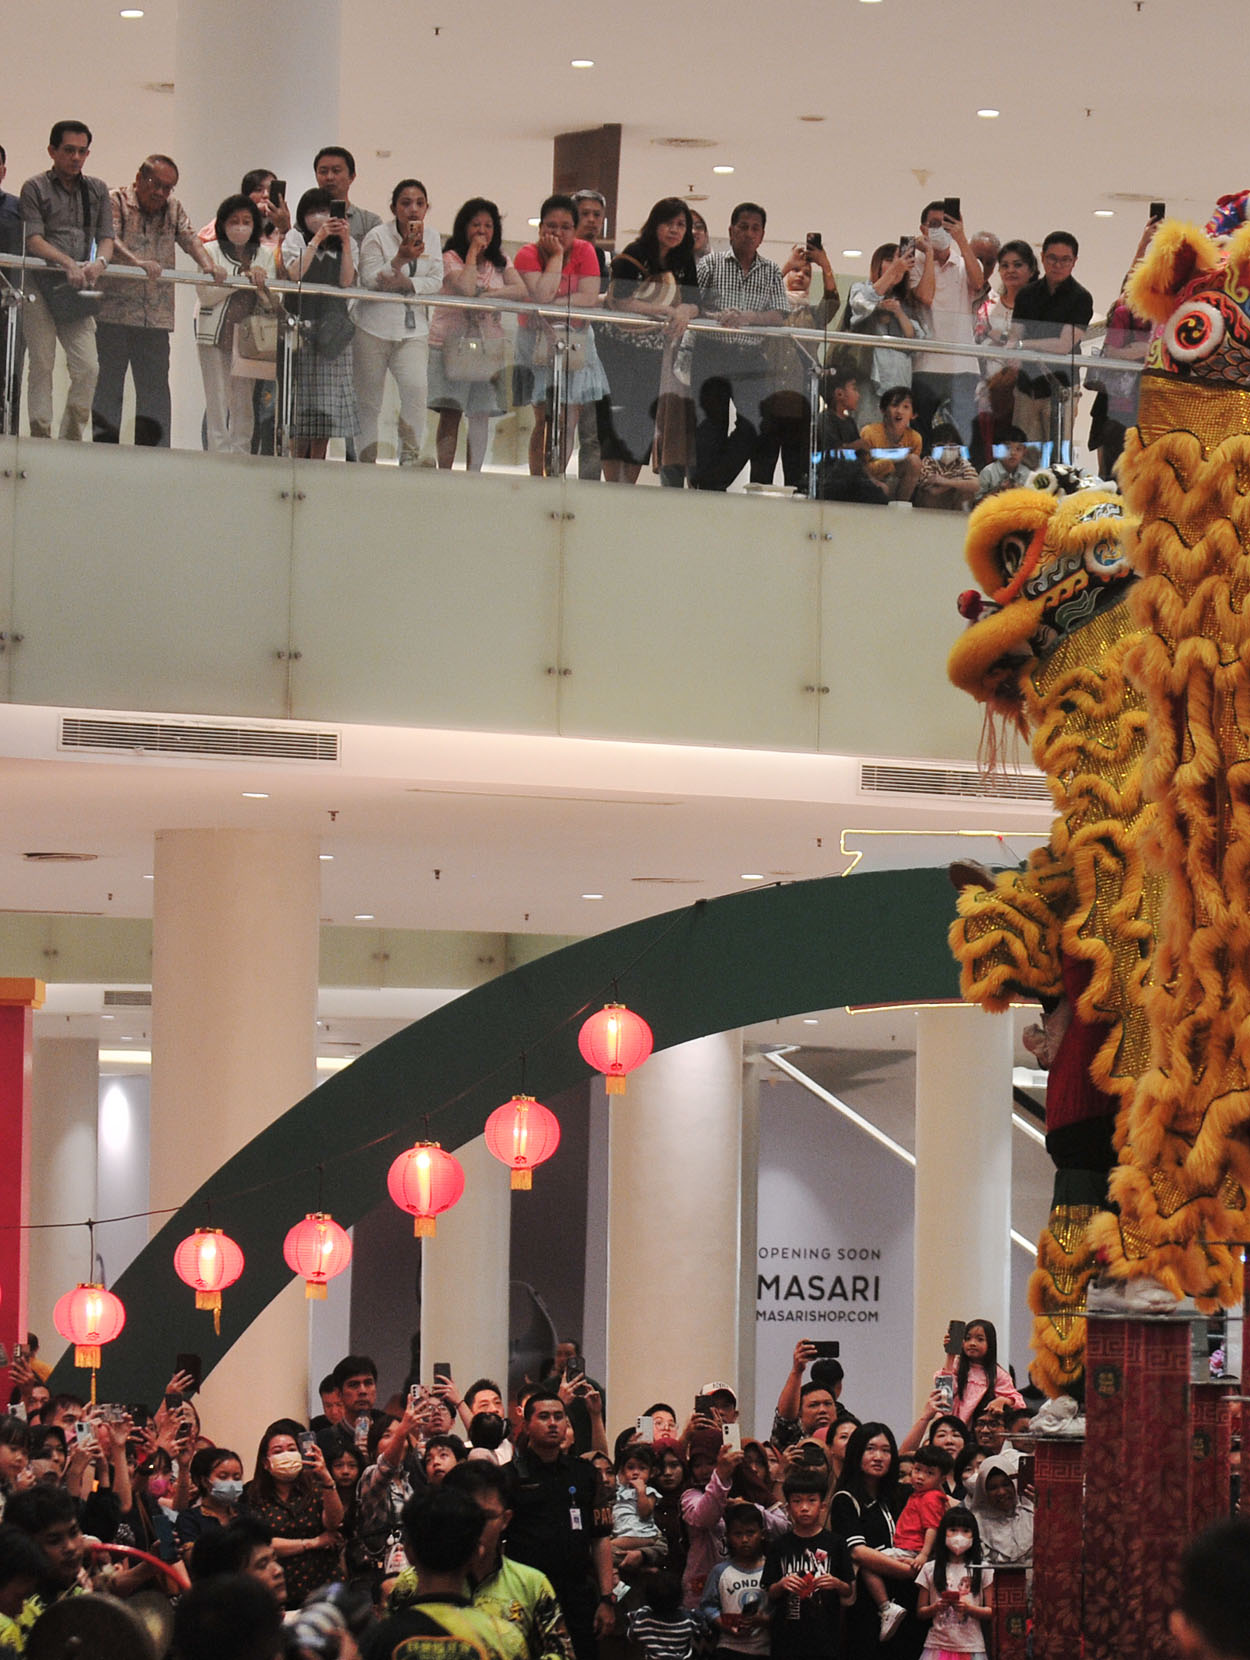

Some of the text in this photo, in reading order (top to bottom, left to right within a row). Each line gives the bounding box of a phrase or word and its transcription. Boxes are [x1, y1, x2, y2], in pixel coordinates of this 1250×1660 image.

[758, 1247, 881, 1261] OPENING SOON
[757, 1274, 880, 1302] MASARI
[756, 1310, 879, 1323] MASARISHOP.COM
